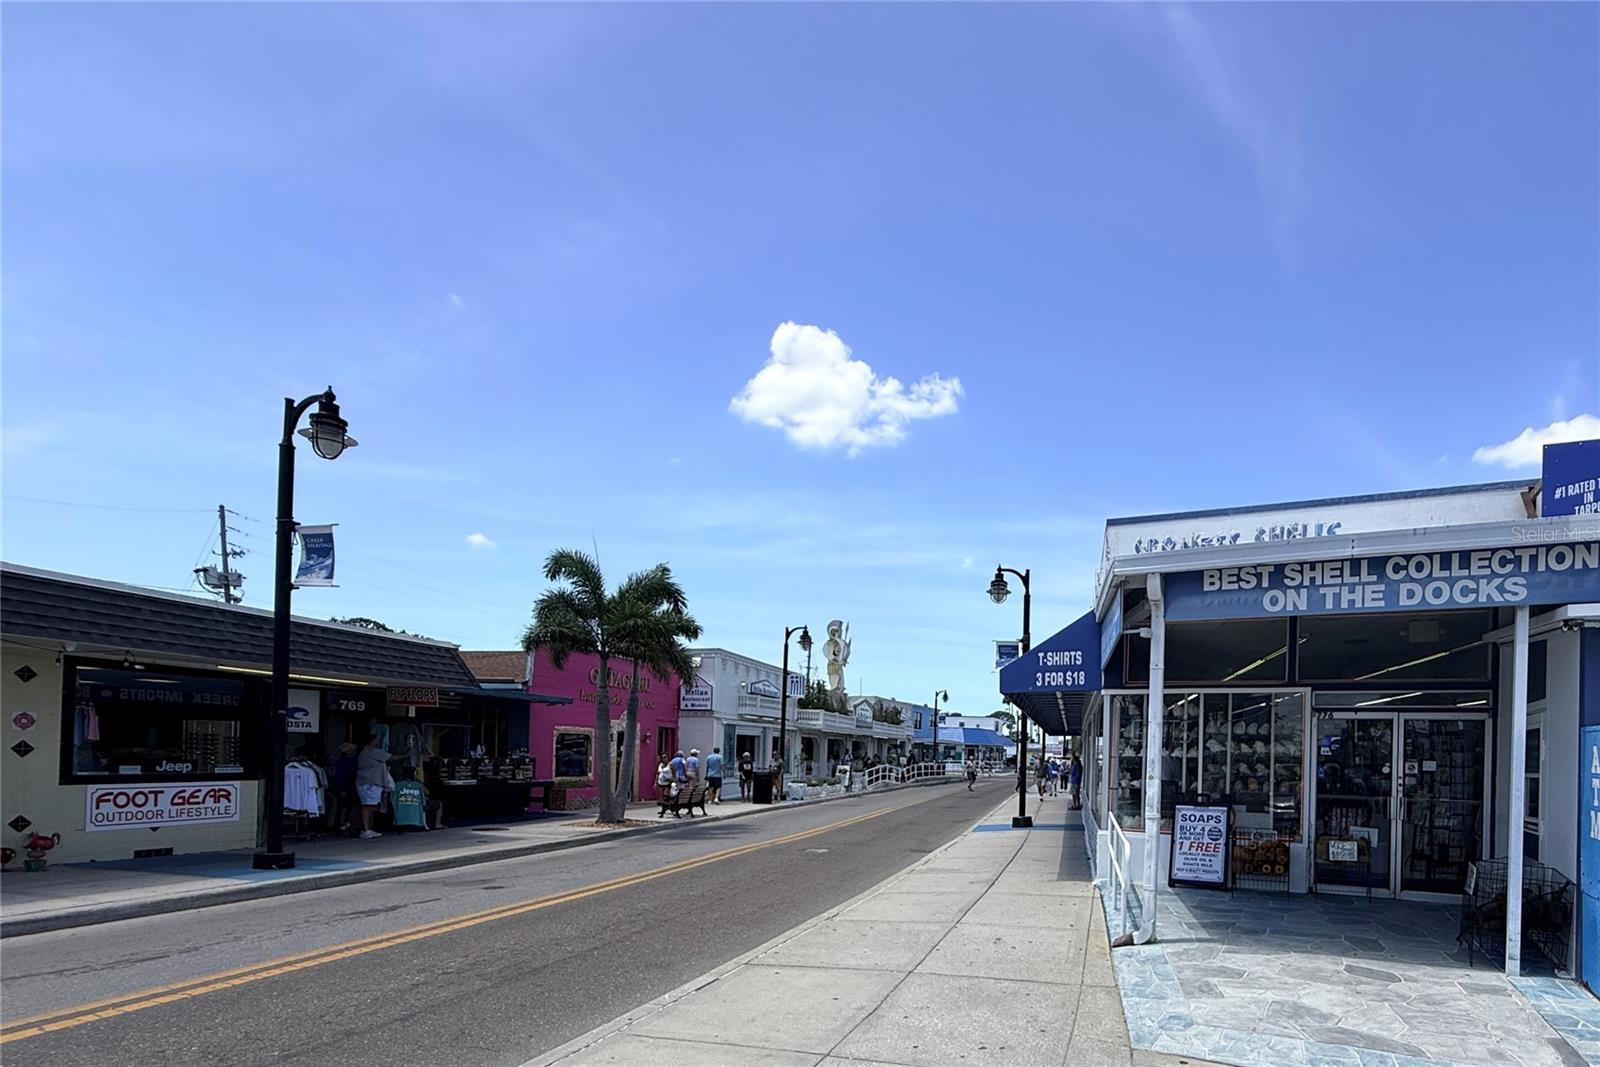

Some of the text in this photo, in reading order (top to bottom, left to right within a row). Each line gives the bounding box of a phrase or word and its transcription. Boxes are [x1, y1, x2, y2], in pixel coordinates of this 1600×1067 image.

[1554, 486, 1566, 499] #1
[1568, 479, 1596, 496] RATED
[1584, 491, 1594, 504] IN
[1203, 543, 1600, 592] BEST SHELL COLLECTION
[1262, 576, 1528, 613] ON THE DOCKS
[1038, 651, 1082, 666] T-SHIRTS
[1036, 670, 1085, 686] 3 FOR $18
[339, 700, 366, 711] 769
[156, 760, 192, 773] Jeep
[95, 788, 232, 810] FOOT GEAR
[94, 806, 232, 823] OUTDOOR LIFESTYLE
[1181, 813, 1222, 824] SOAPS
[1179, 841, 1222, 853] 1 FREE
